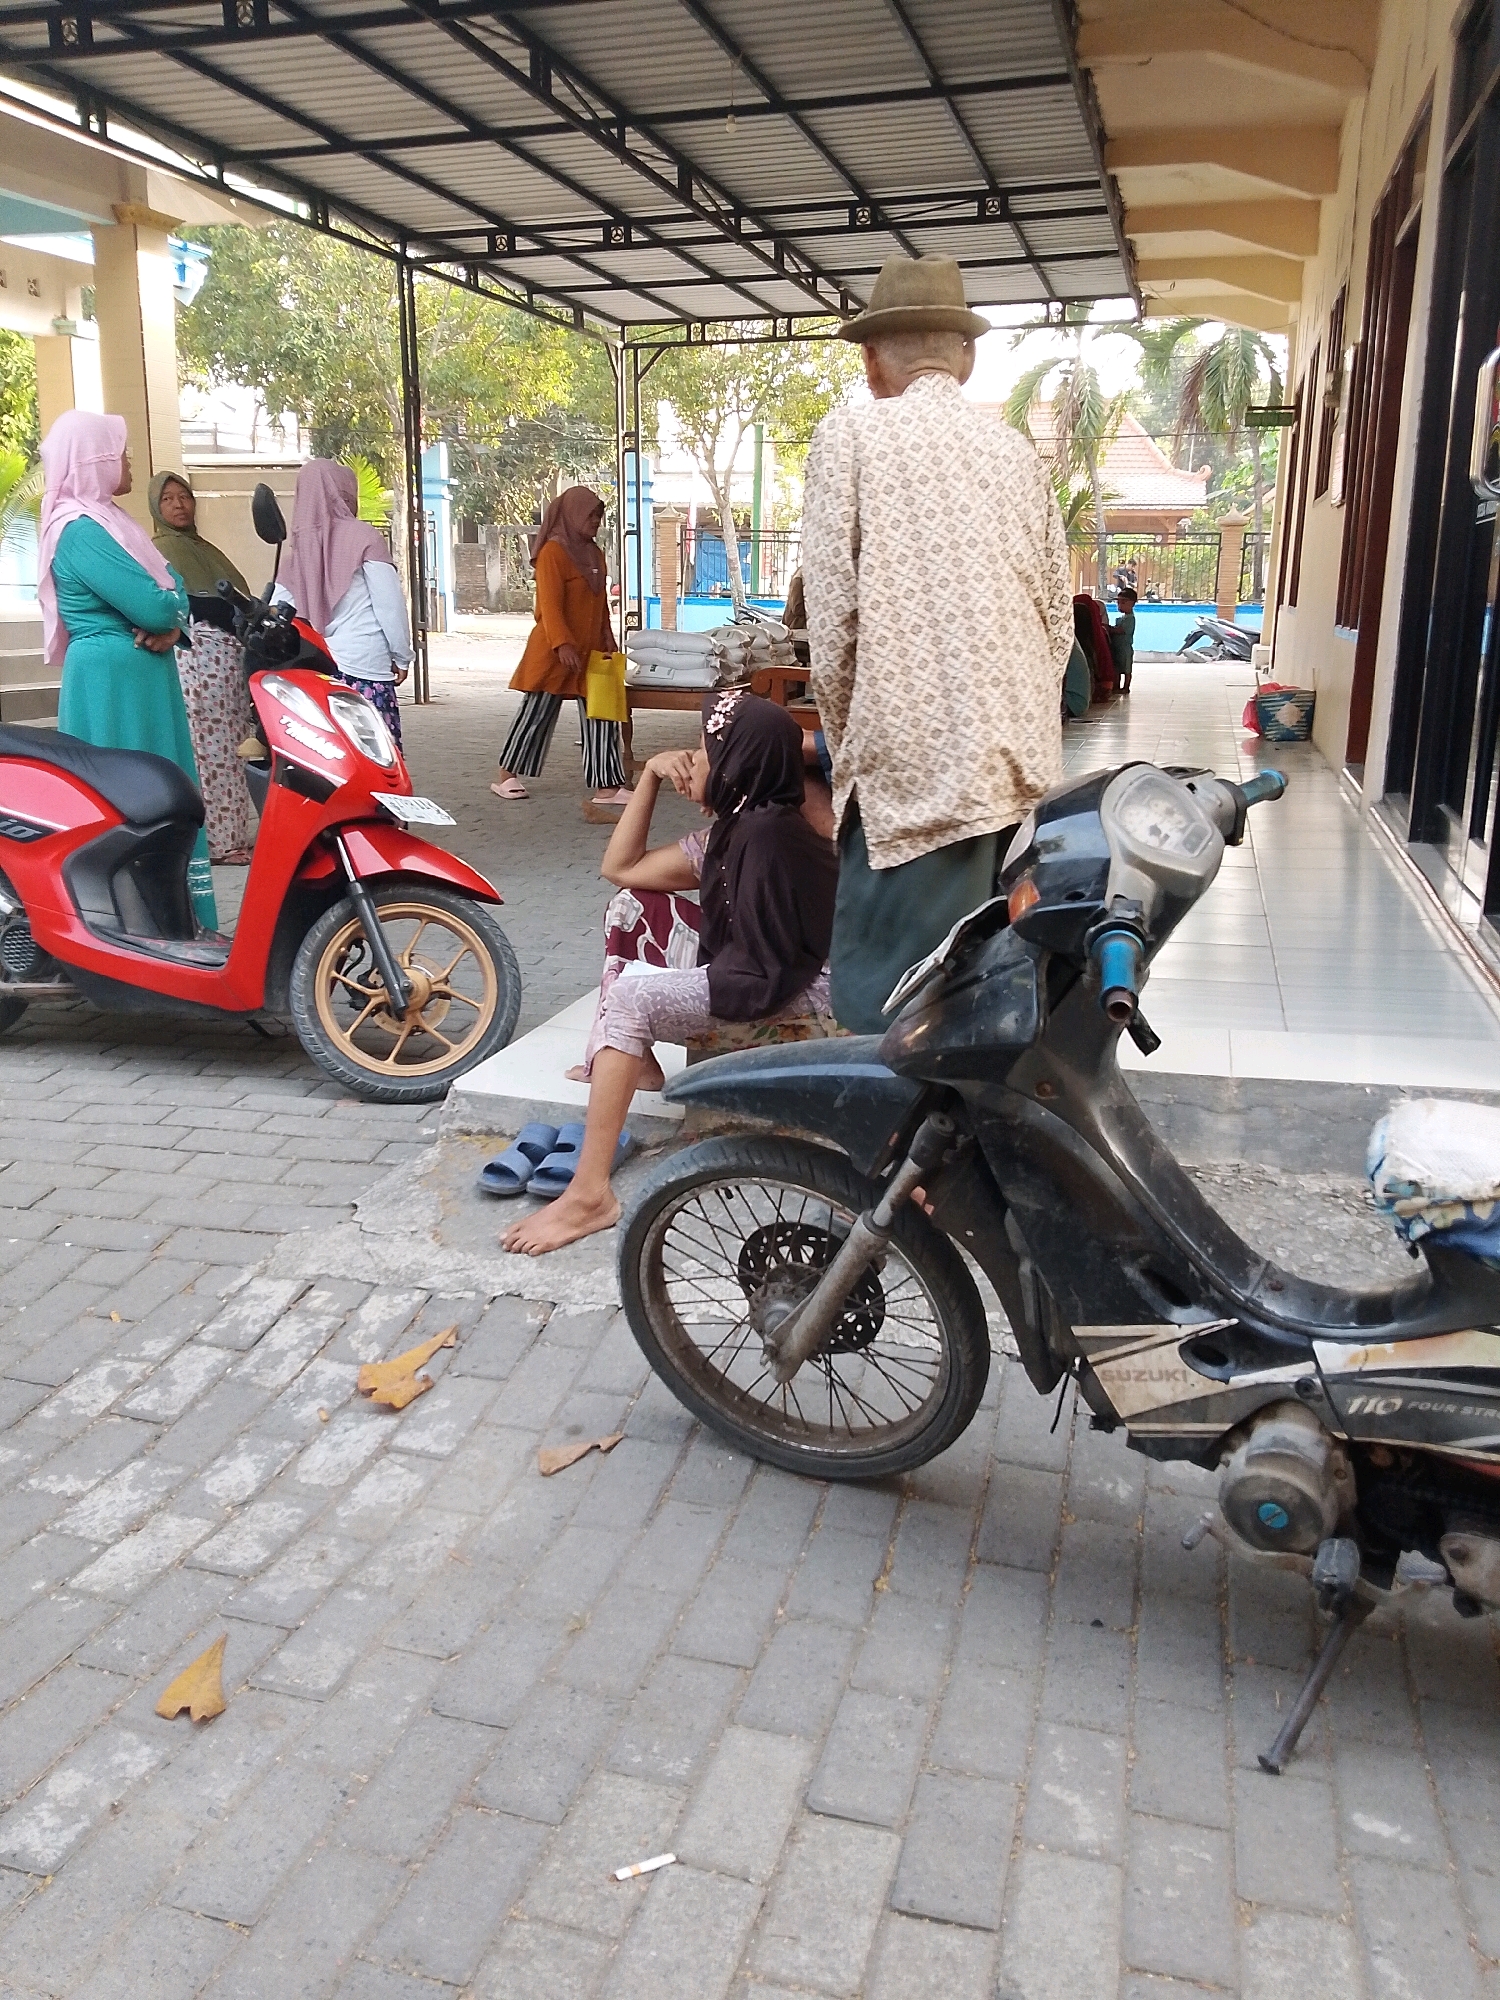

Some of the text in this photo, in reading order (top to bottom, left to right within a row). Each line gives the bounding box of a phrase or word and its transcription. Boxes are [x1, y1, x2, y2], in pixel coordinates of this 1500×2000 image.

[1100, 1368, 1188, 1382] SUZUKI
[1347, 1394, 1403, 1416] 110
[1407, 1401, 1458, 1414] FOUR
